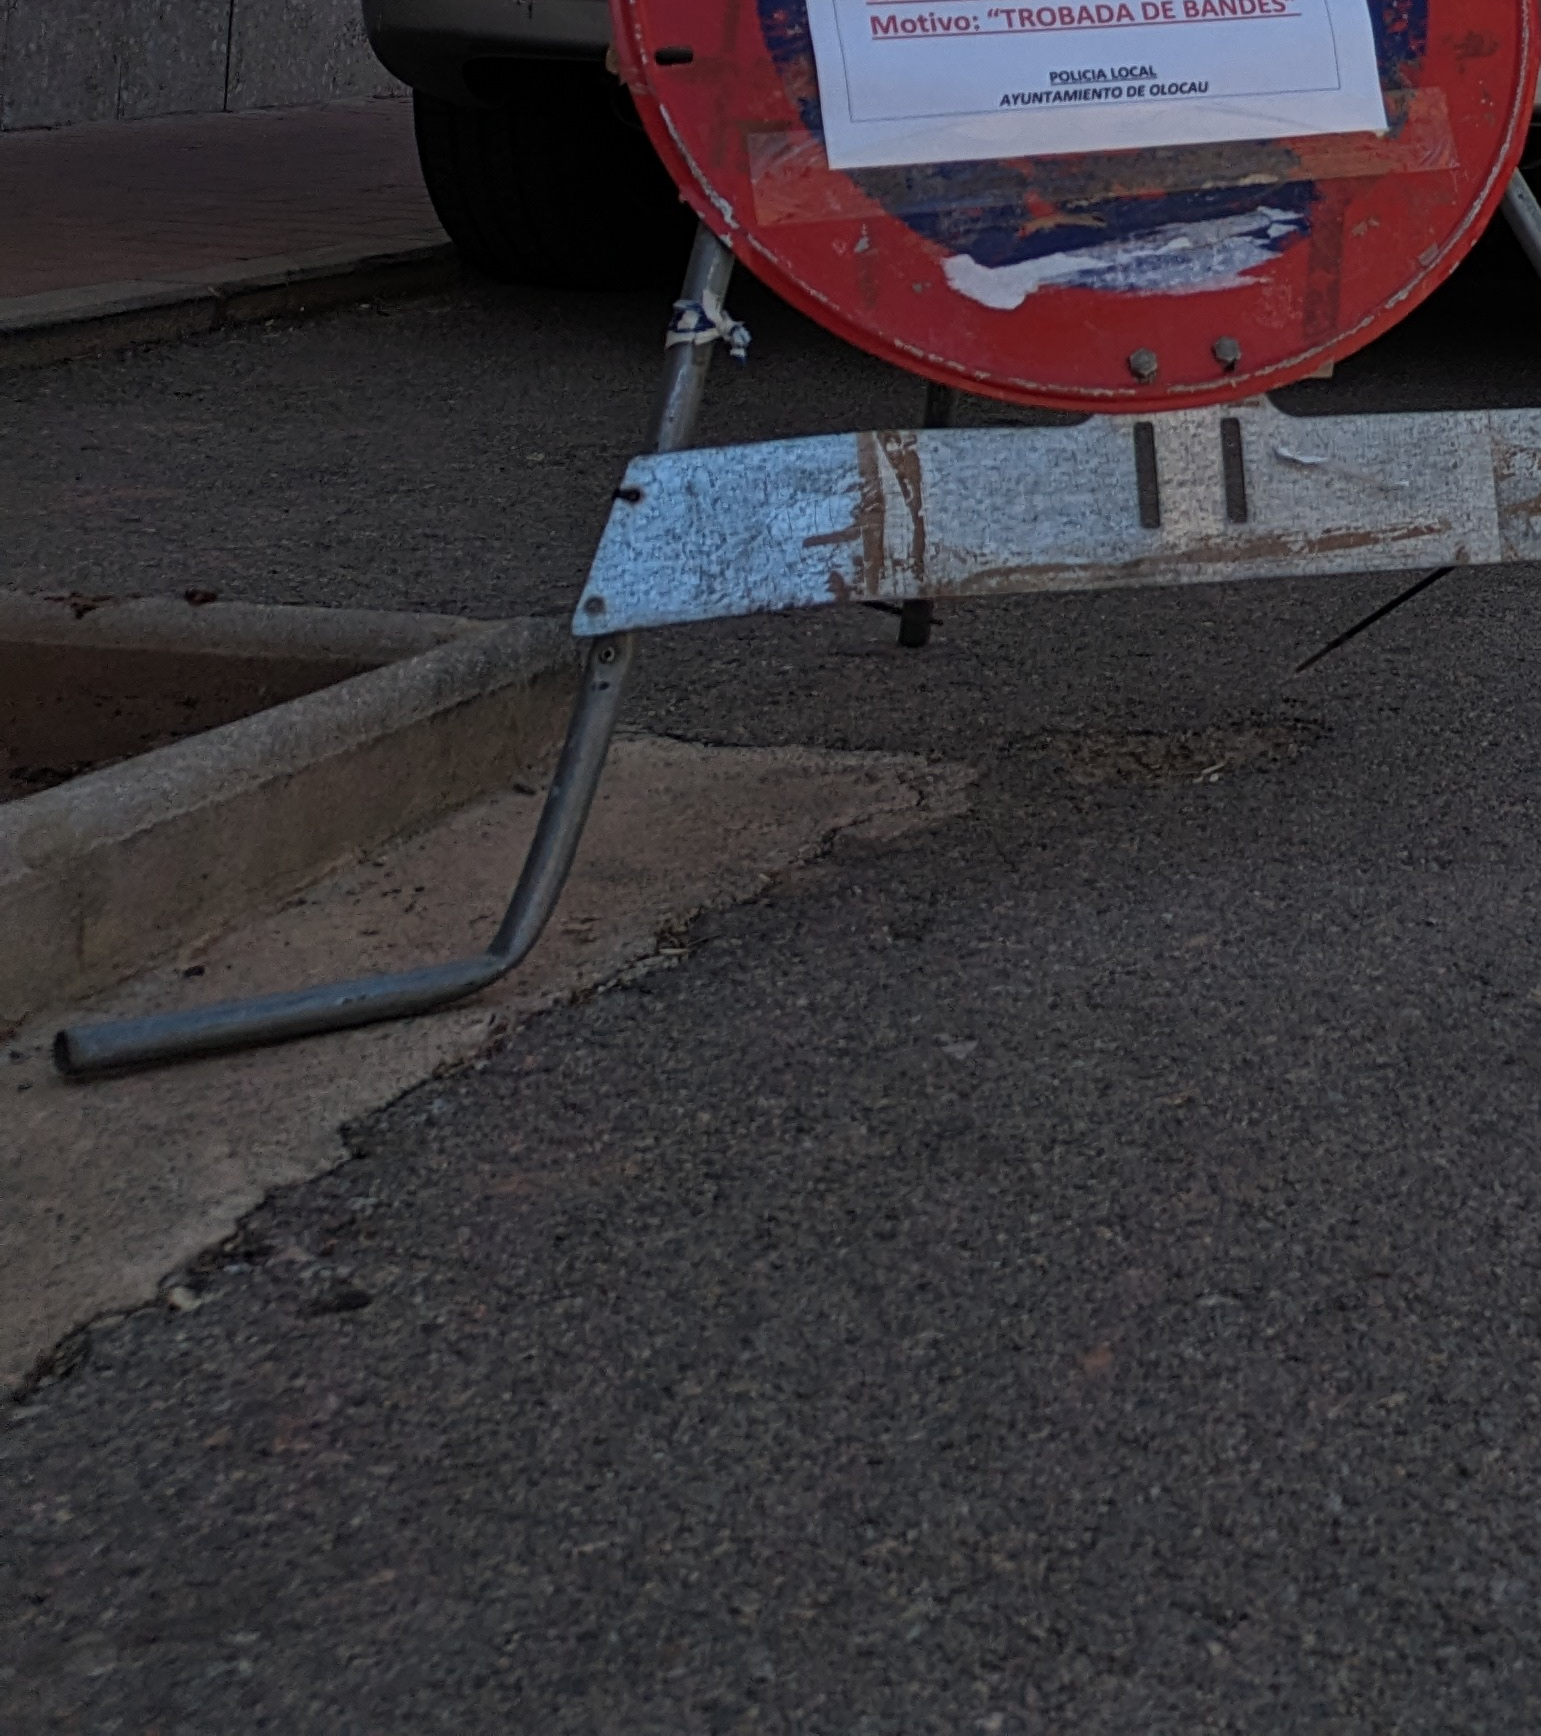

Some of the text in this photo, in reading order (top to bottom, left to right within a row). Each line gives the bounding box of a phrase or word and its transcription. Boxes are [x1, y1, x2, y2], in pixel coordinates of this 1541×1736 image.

[870, 12, 981, 36] Motivo:
[987, 3, 1135, 30] “TROBADA
[1141, 0, 1176, 21] DE
[1049, 65, 1158, 84] POLICIA LOCAL
[999, 81, 1210, 107] AYUNTAMIENTO DE OLOCAU
